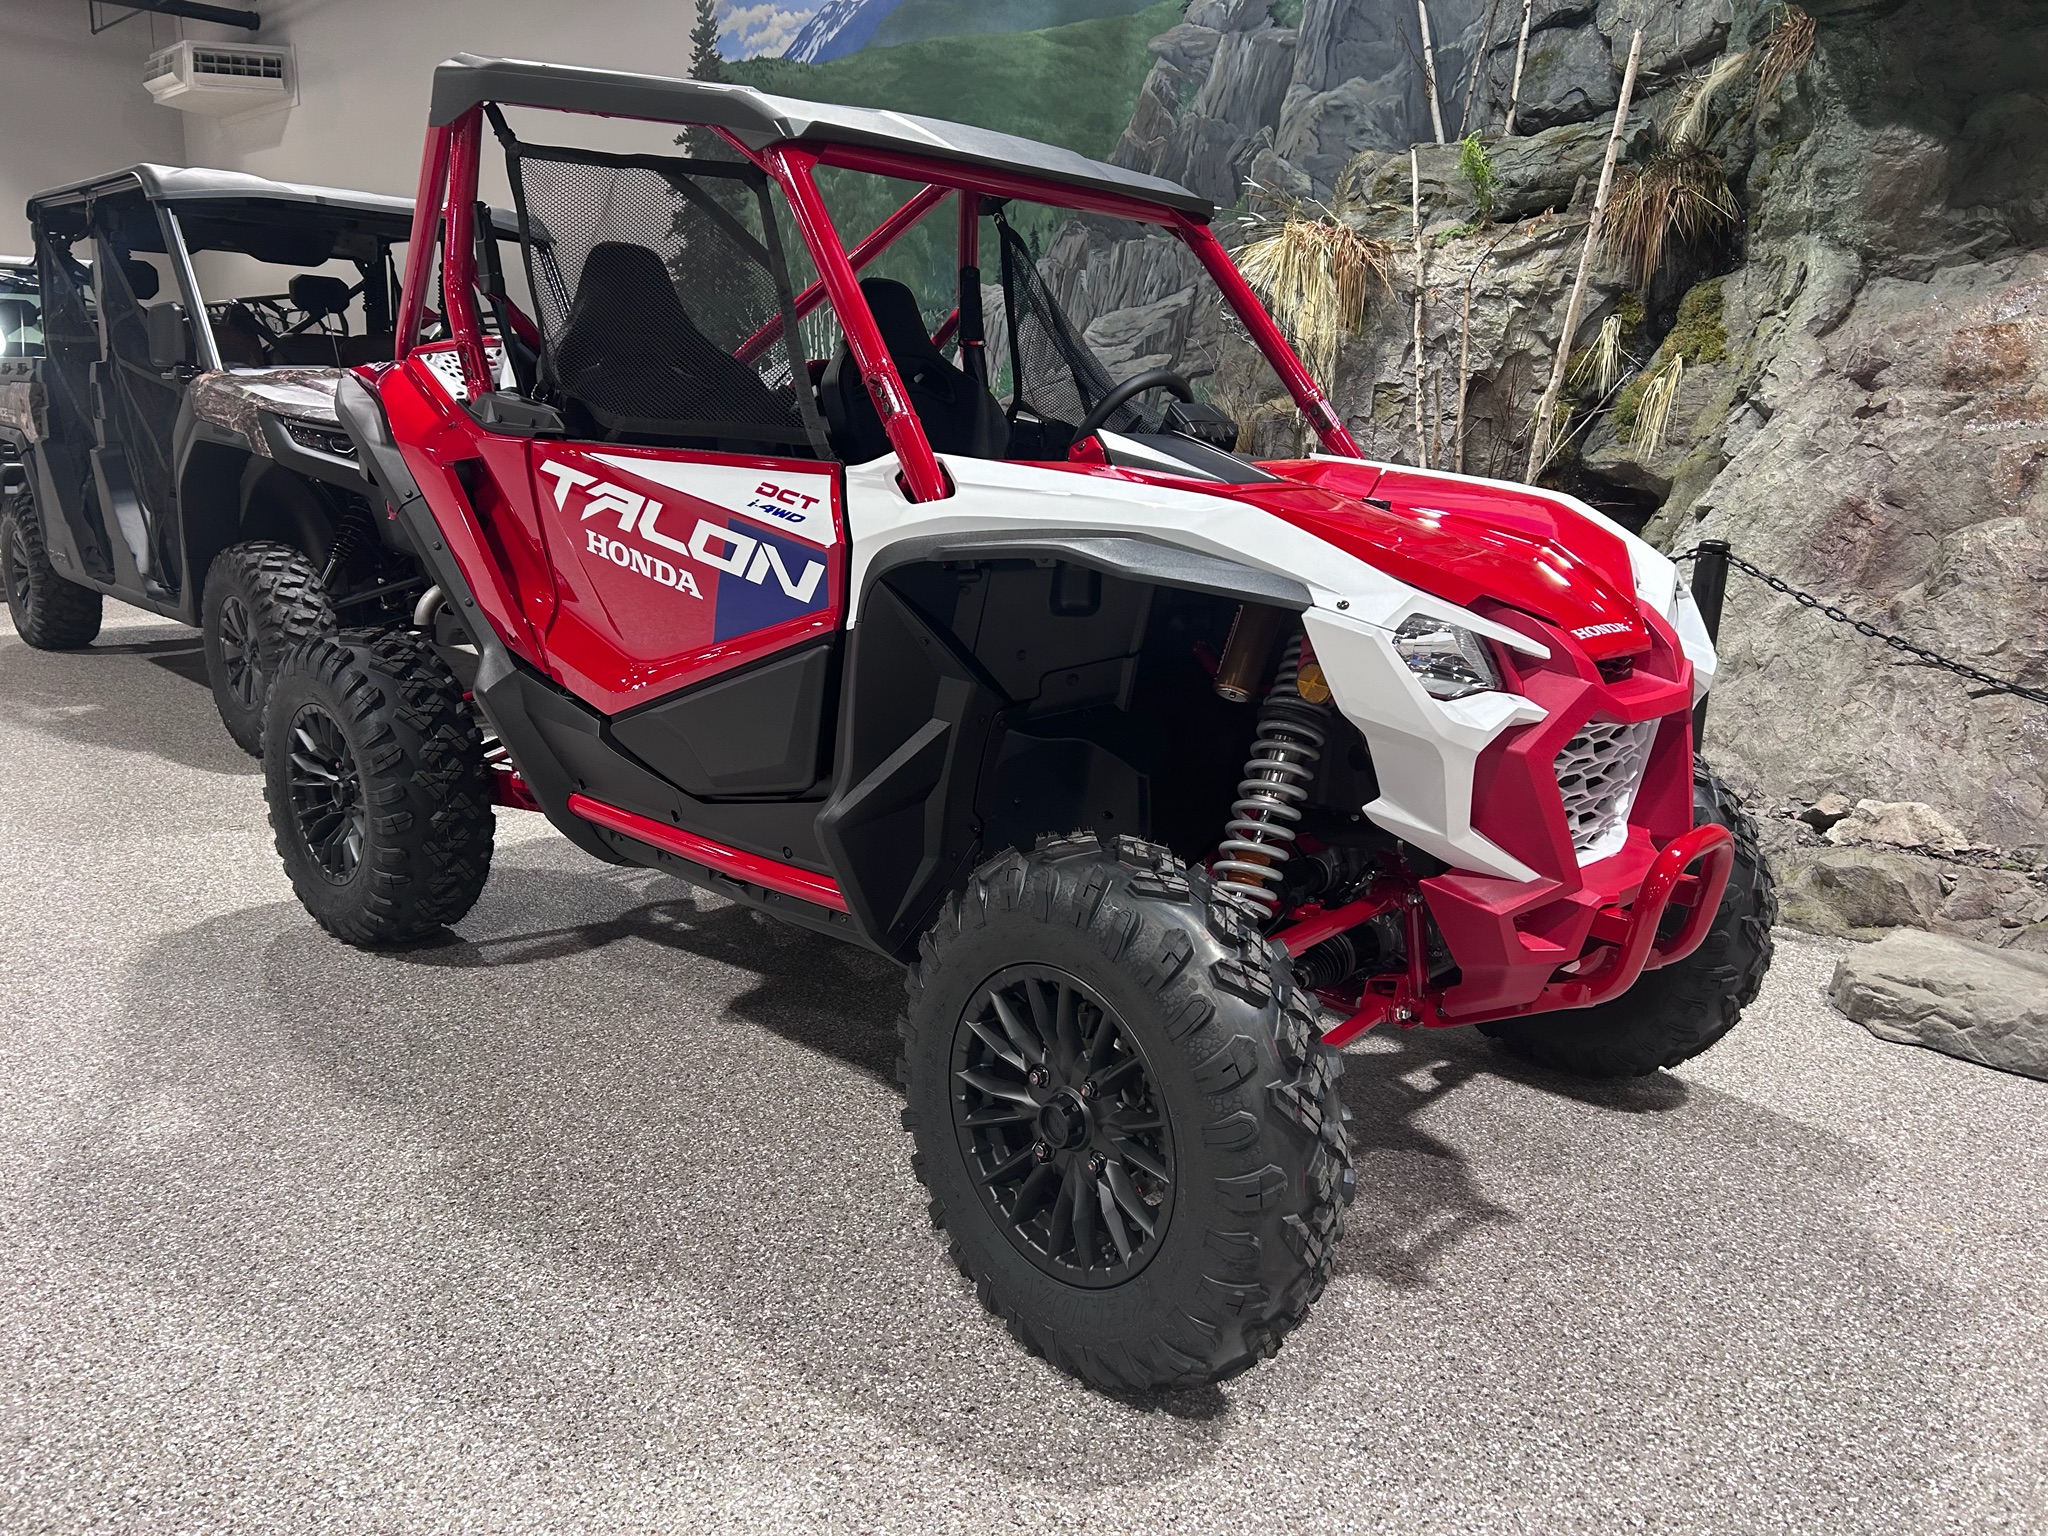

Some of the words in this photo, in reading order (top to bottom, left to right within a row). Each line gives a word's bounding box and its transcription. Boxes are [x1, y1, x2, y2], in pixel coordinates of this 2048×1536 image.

[755, 481, 820, 510] DCT
[747, 499, 807, 524] i-4WD
[540, 459, 826, 604] TALON
[585, 528, 704, 601] HONDA
[1570, 622, 1632, 640] HONDA
